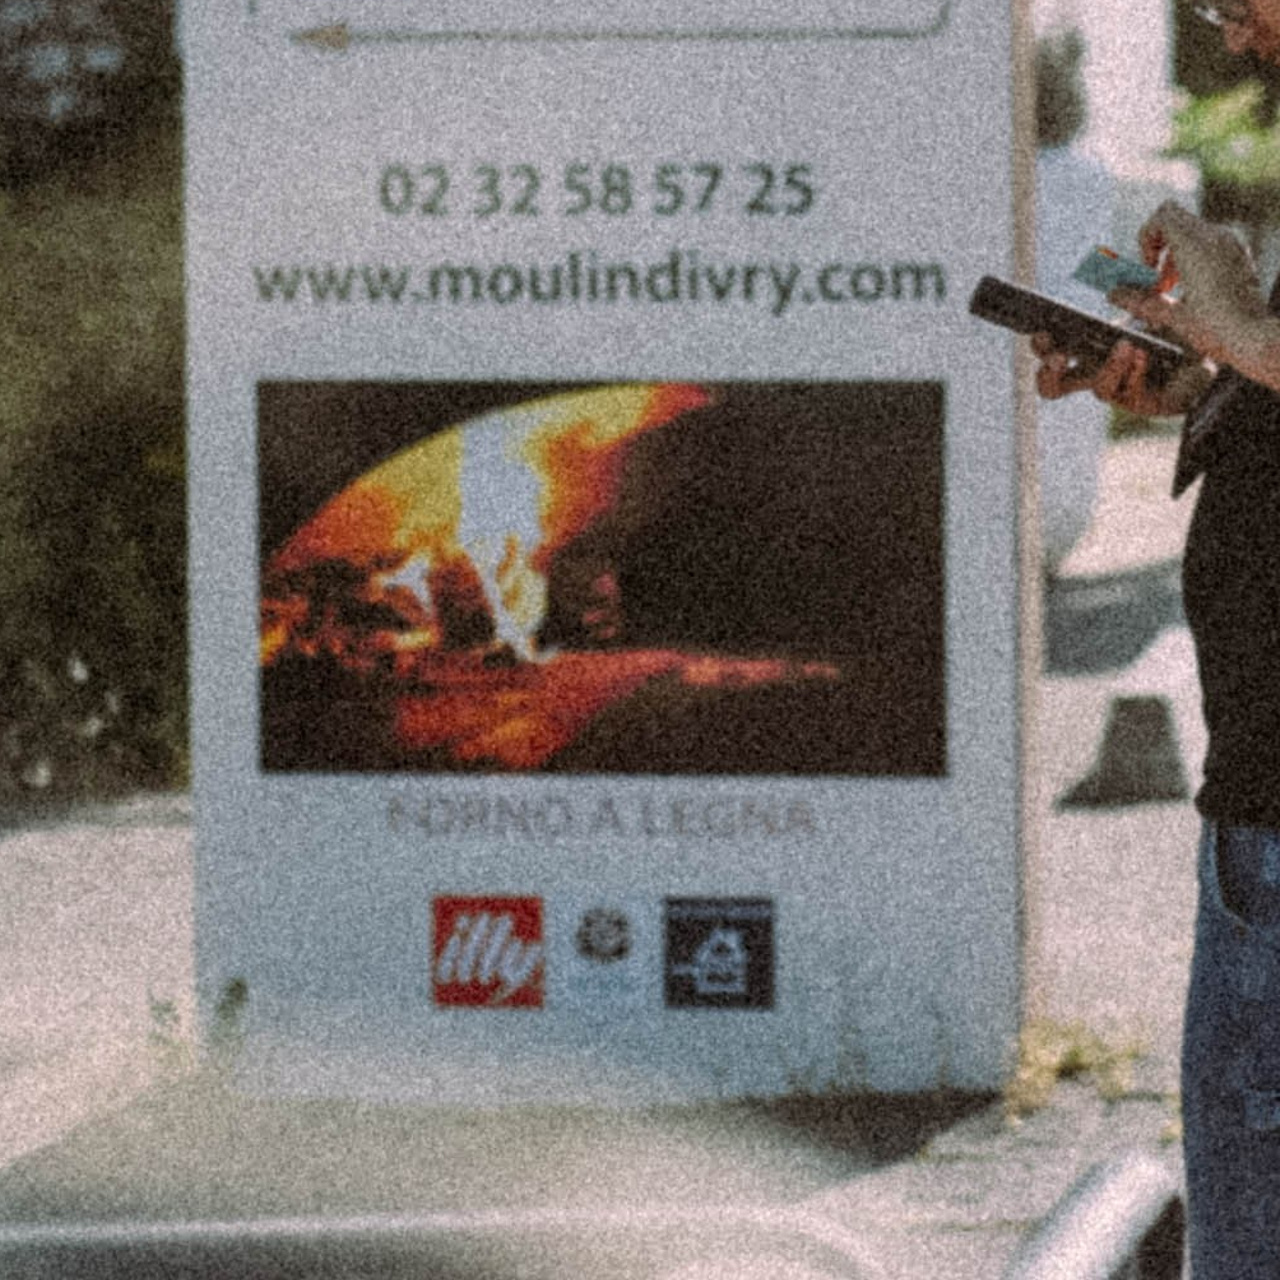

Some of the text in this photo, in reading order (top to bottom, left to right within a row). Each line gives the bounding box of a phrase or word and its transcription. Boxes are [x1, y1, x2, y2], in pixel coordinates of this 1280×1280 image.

[376, 161, 816, 219] 02 32 58 57 25
[253, 248, 948, 318] www.moulindivry.com
[432, 912, 543, 1000] illy
